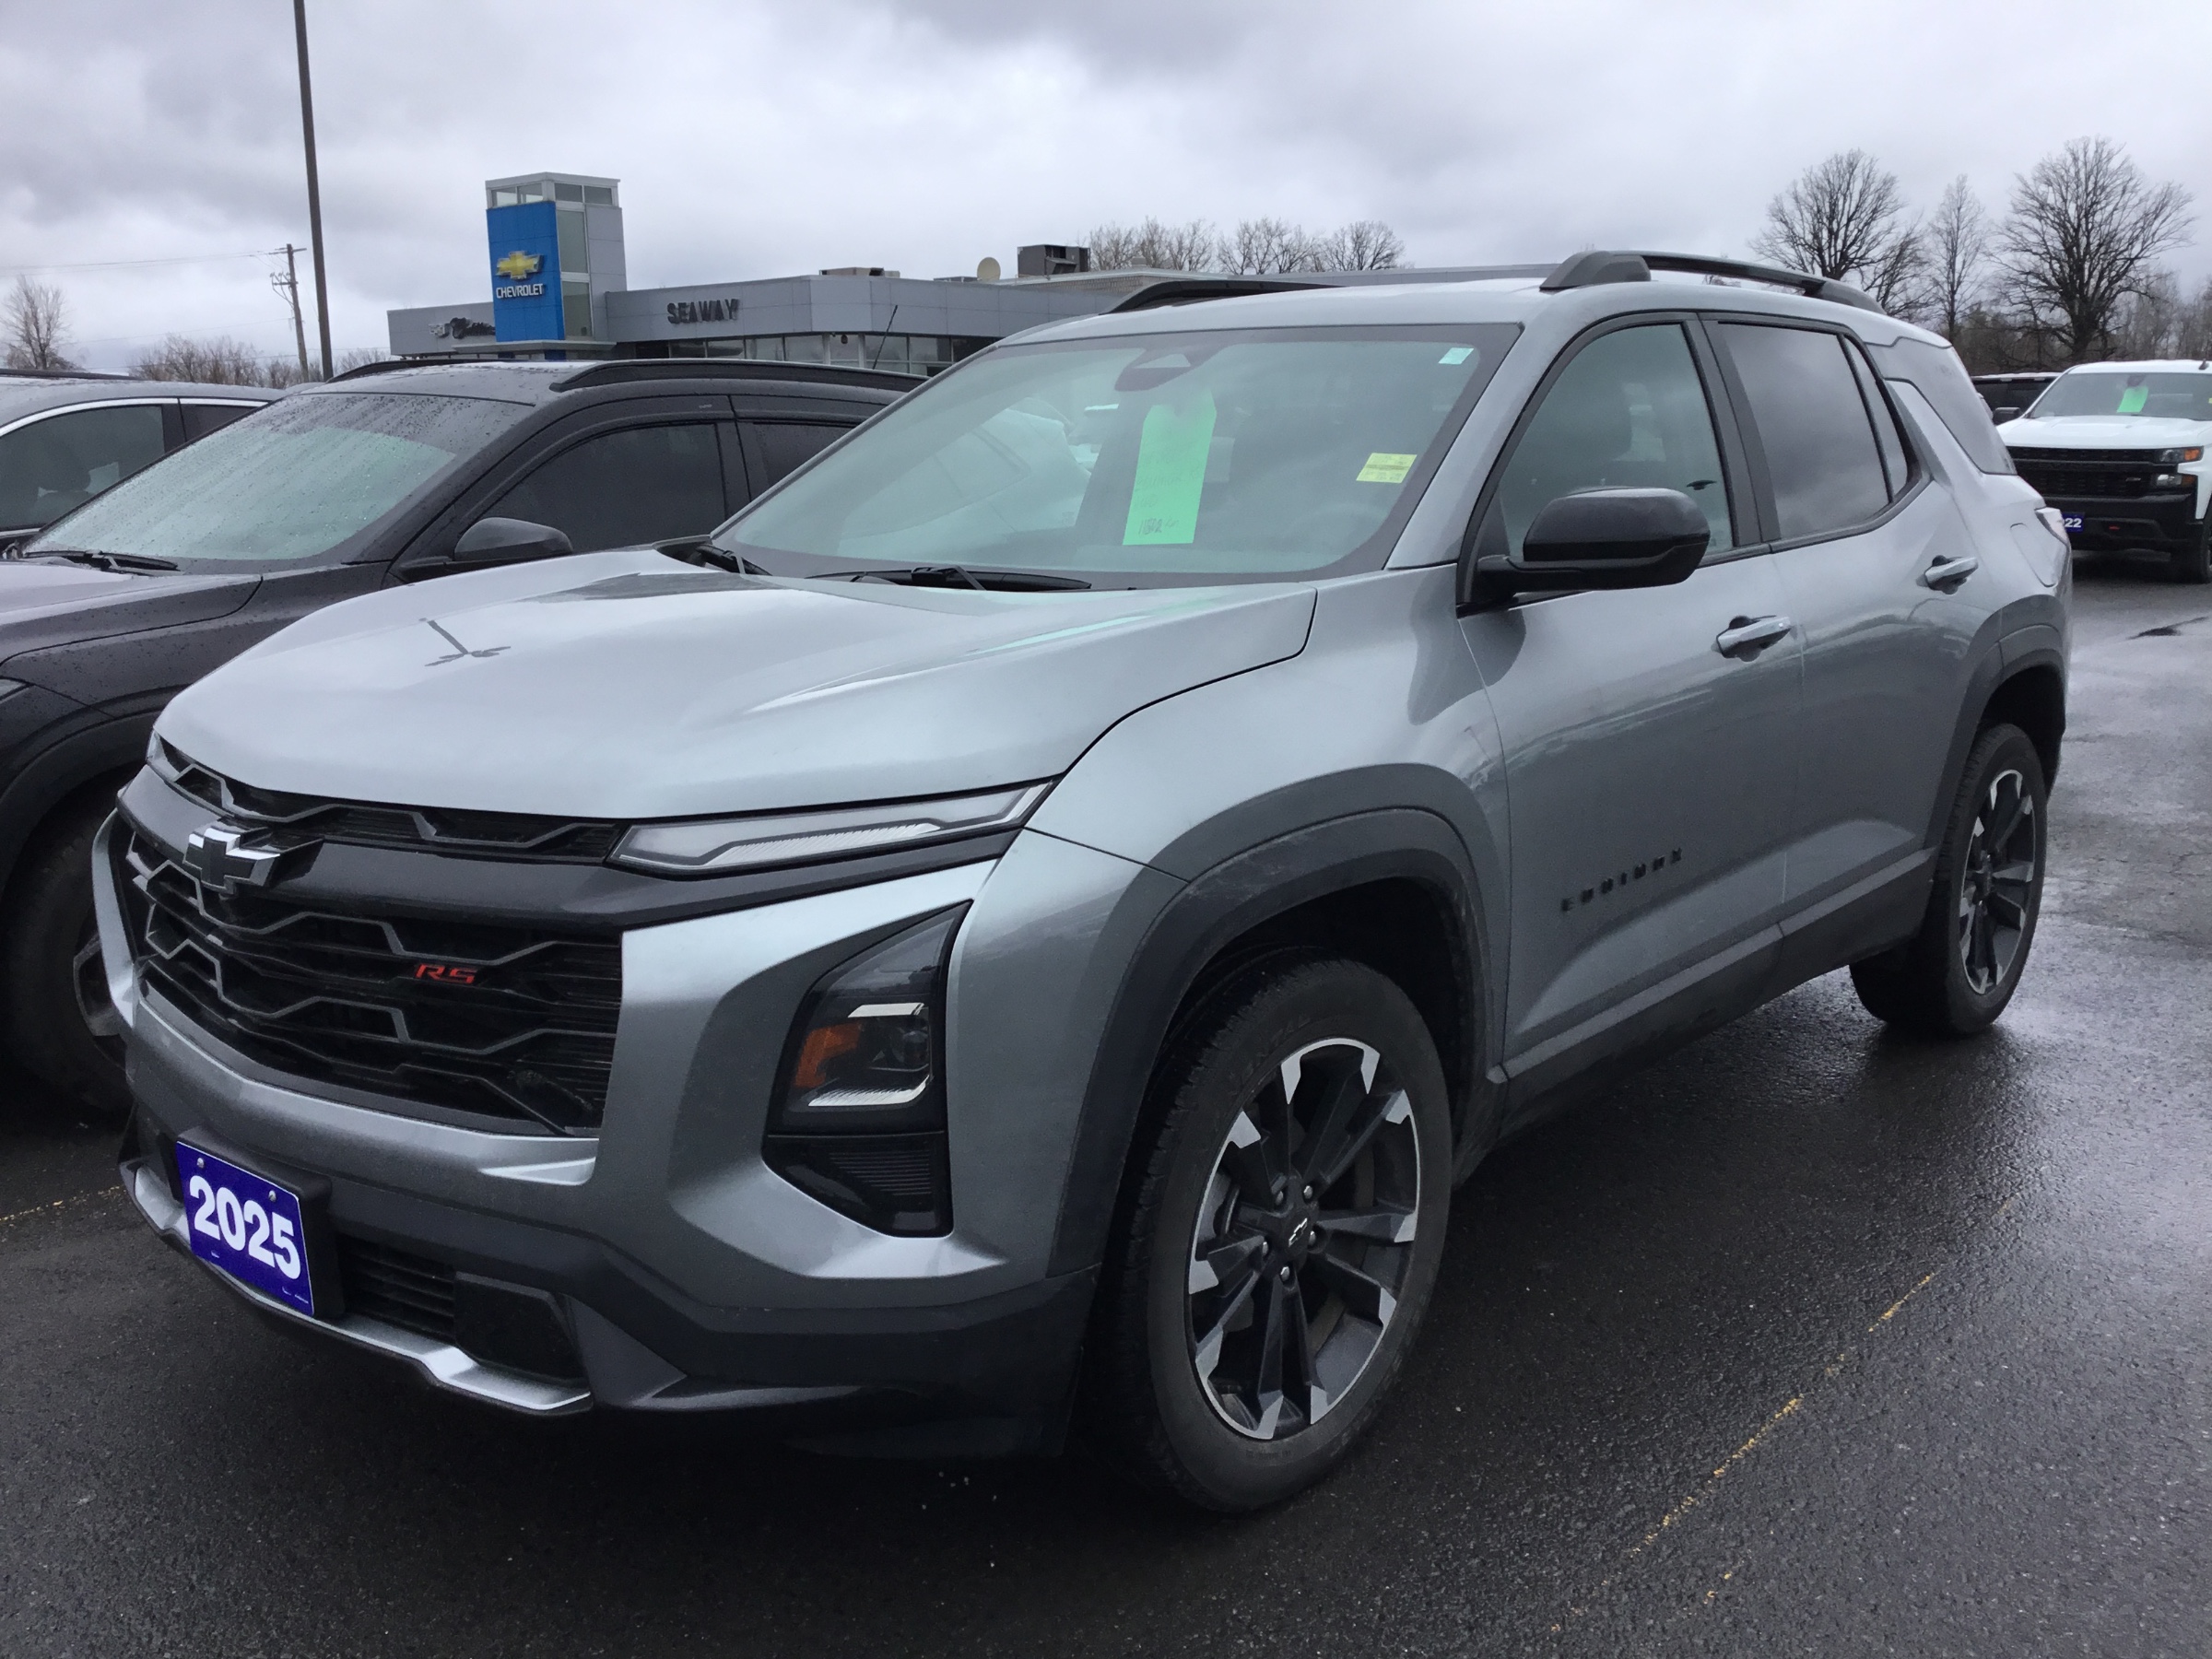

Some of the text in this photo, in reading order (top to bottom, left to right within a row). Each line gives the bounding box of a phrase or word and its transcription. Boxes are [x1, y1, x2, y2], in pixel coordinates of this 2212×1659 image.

[496, 283, 543, 299] CHEVROLET
[666, 298, 740, 324] SEAWAY
[2062, 517, 2082, 528] 22
[416, 964, 477, 983] RS
[189, 1175, 301, 1279] 2025
